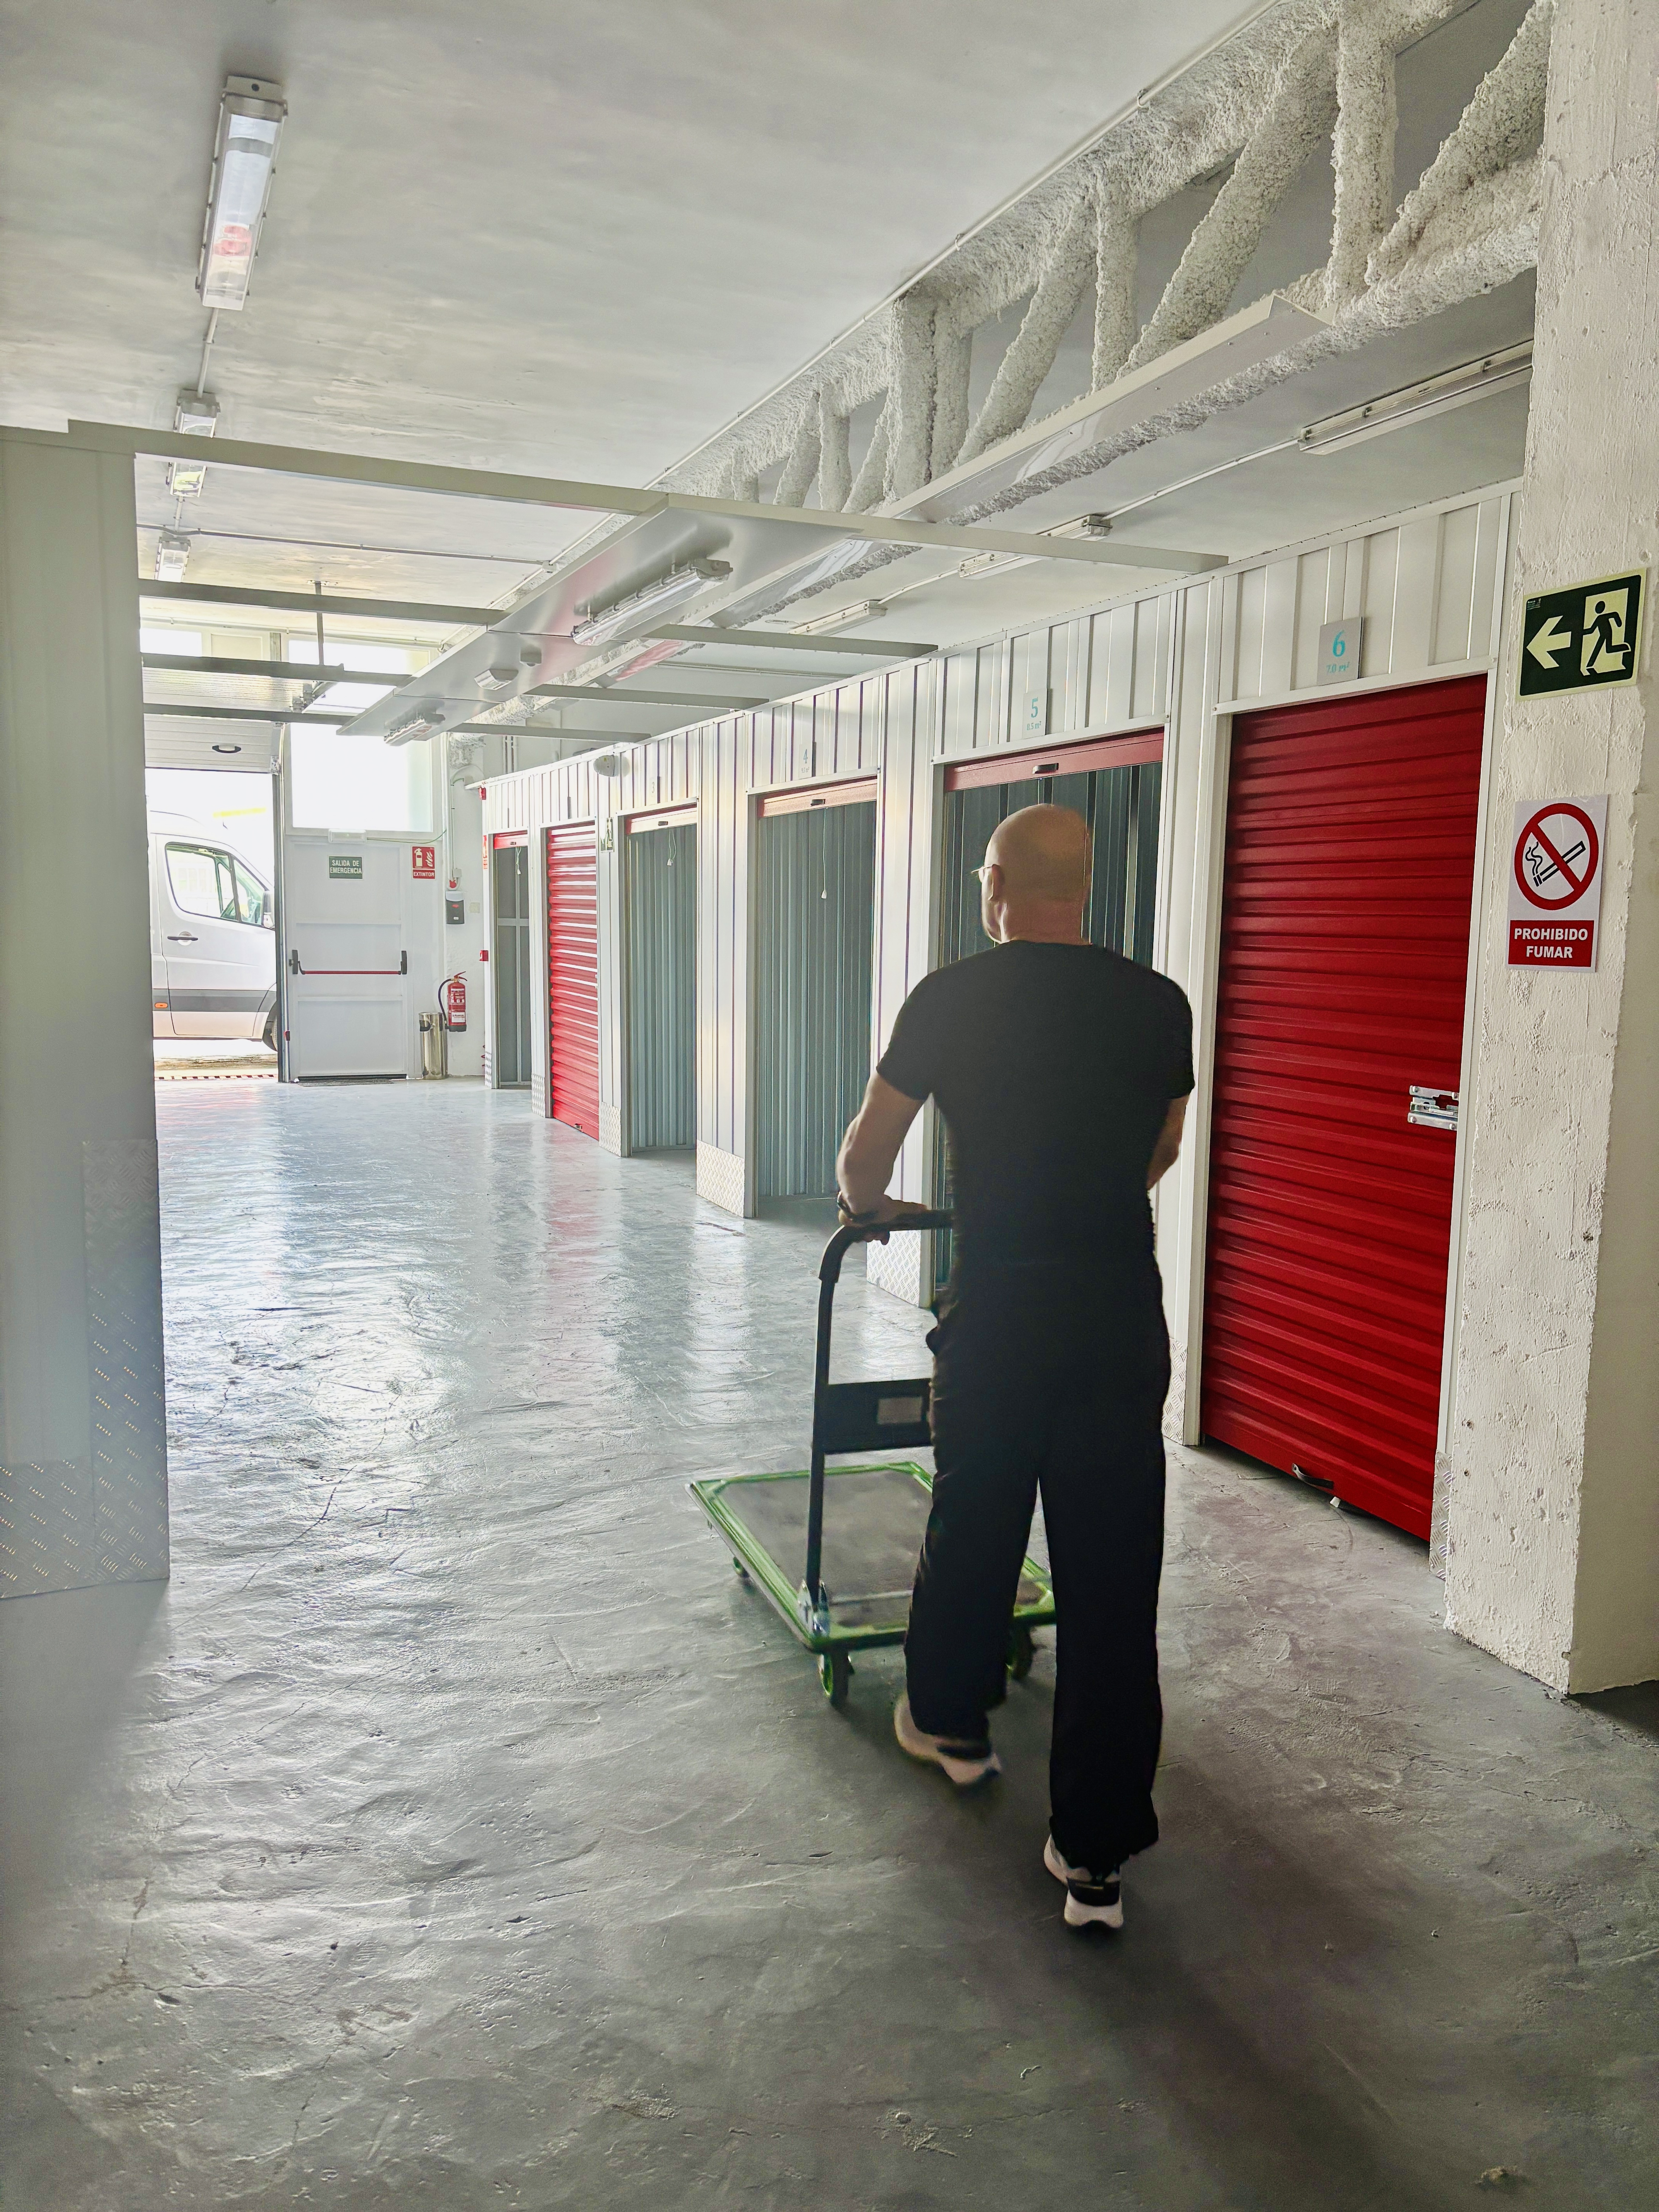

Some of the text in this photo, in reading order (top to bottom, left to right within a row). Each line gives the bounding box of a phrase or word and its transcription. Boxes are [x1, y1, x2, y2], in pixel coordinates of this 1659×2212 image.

[1332, 629, 1345, 657] 6
[1031, 697, 1038, 718] 5
[803, 749, 808, 764] 4
[652, 782, 654, 793] 3
[1514, 928, 1588, 941] PROHIBIDO
[1526, 946, 1573, 958] FUMAR
